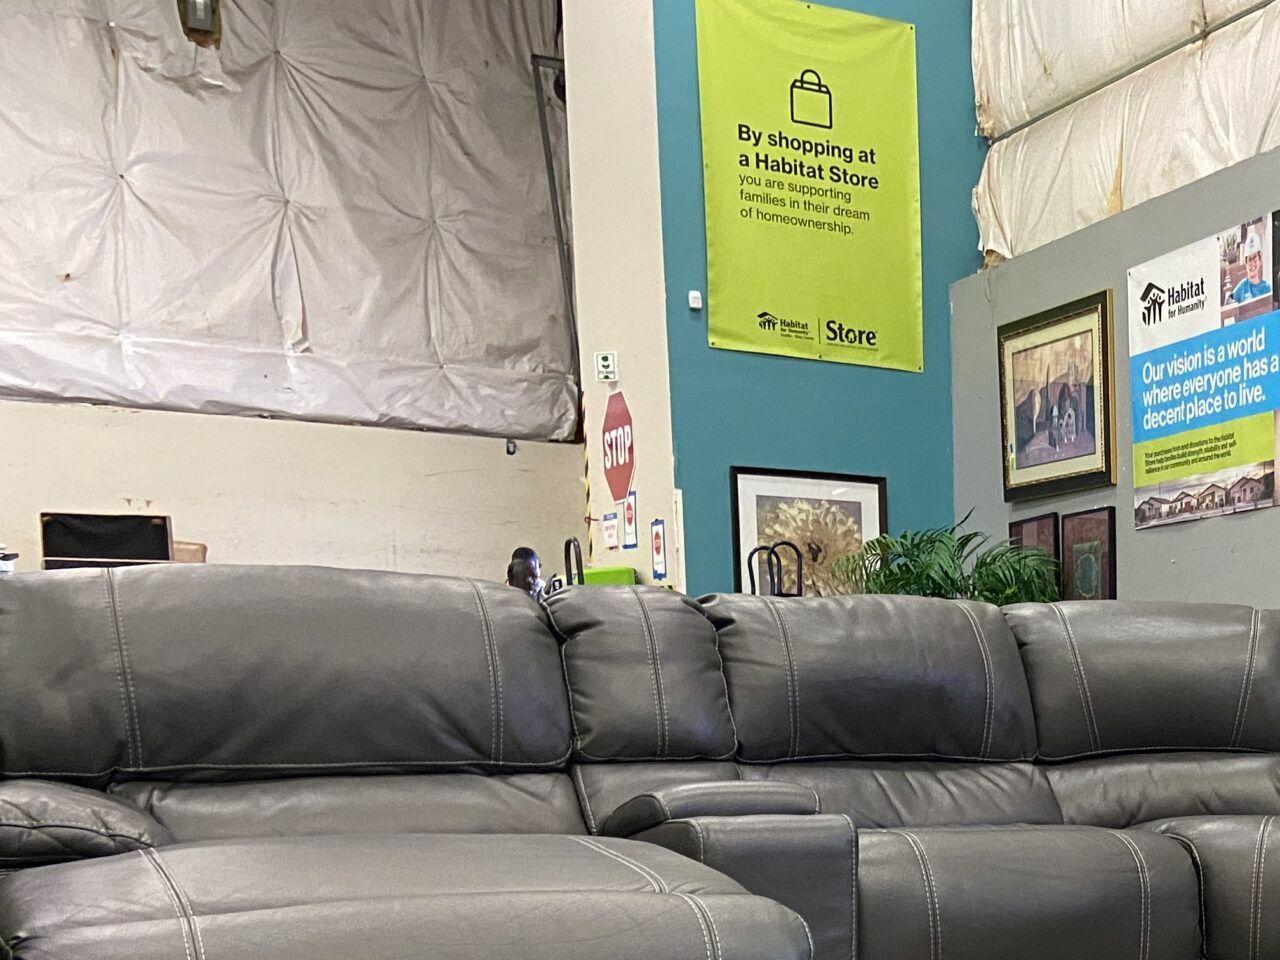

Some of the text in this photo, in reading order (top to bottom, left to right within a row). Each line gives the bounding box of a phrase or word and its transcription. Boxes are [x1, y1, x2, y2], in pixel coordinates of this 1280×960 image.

[738, 124, 876, 164] By shopping at
[739, 153, 878, 189] a Habitat Store
[739, 174, 851, 203] you are supporting
[740, 189, 870, 220] families in their dream
[740, 207, 854, 235] of homeownership.
[1168, 278, 1204, 306] Habitat
[780, 319, 808, 330] Habitat
[1168, 300, 1205, 319] for Humanity
[826, 320, 876, 346] Store
[1142, 327, 1265, 384] Our vision is a world
[1143, 355, 1279, 407] where everyone has a
[1143, 383, 1265, 430] decent place to live.
[604, 424, 631, 469] STOP
